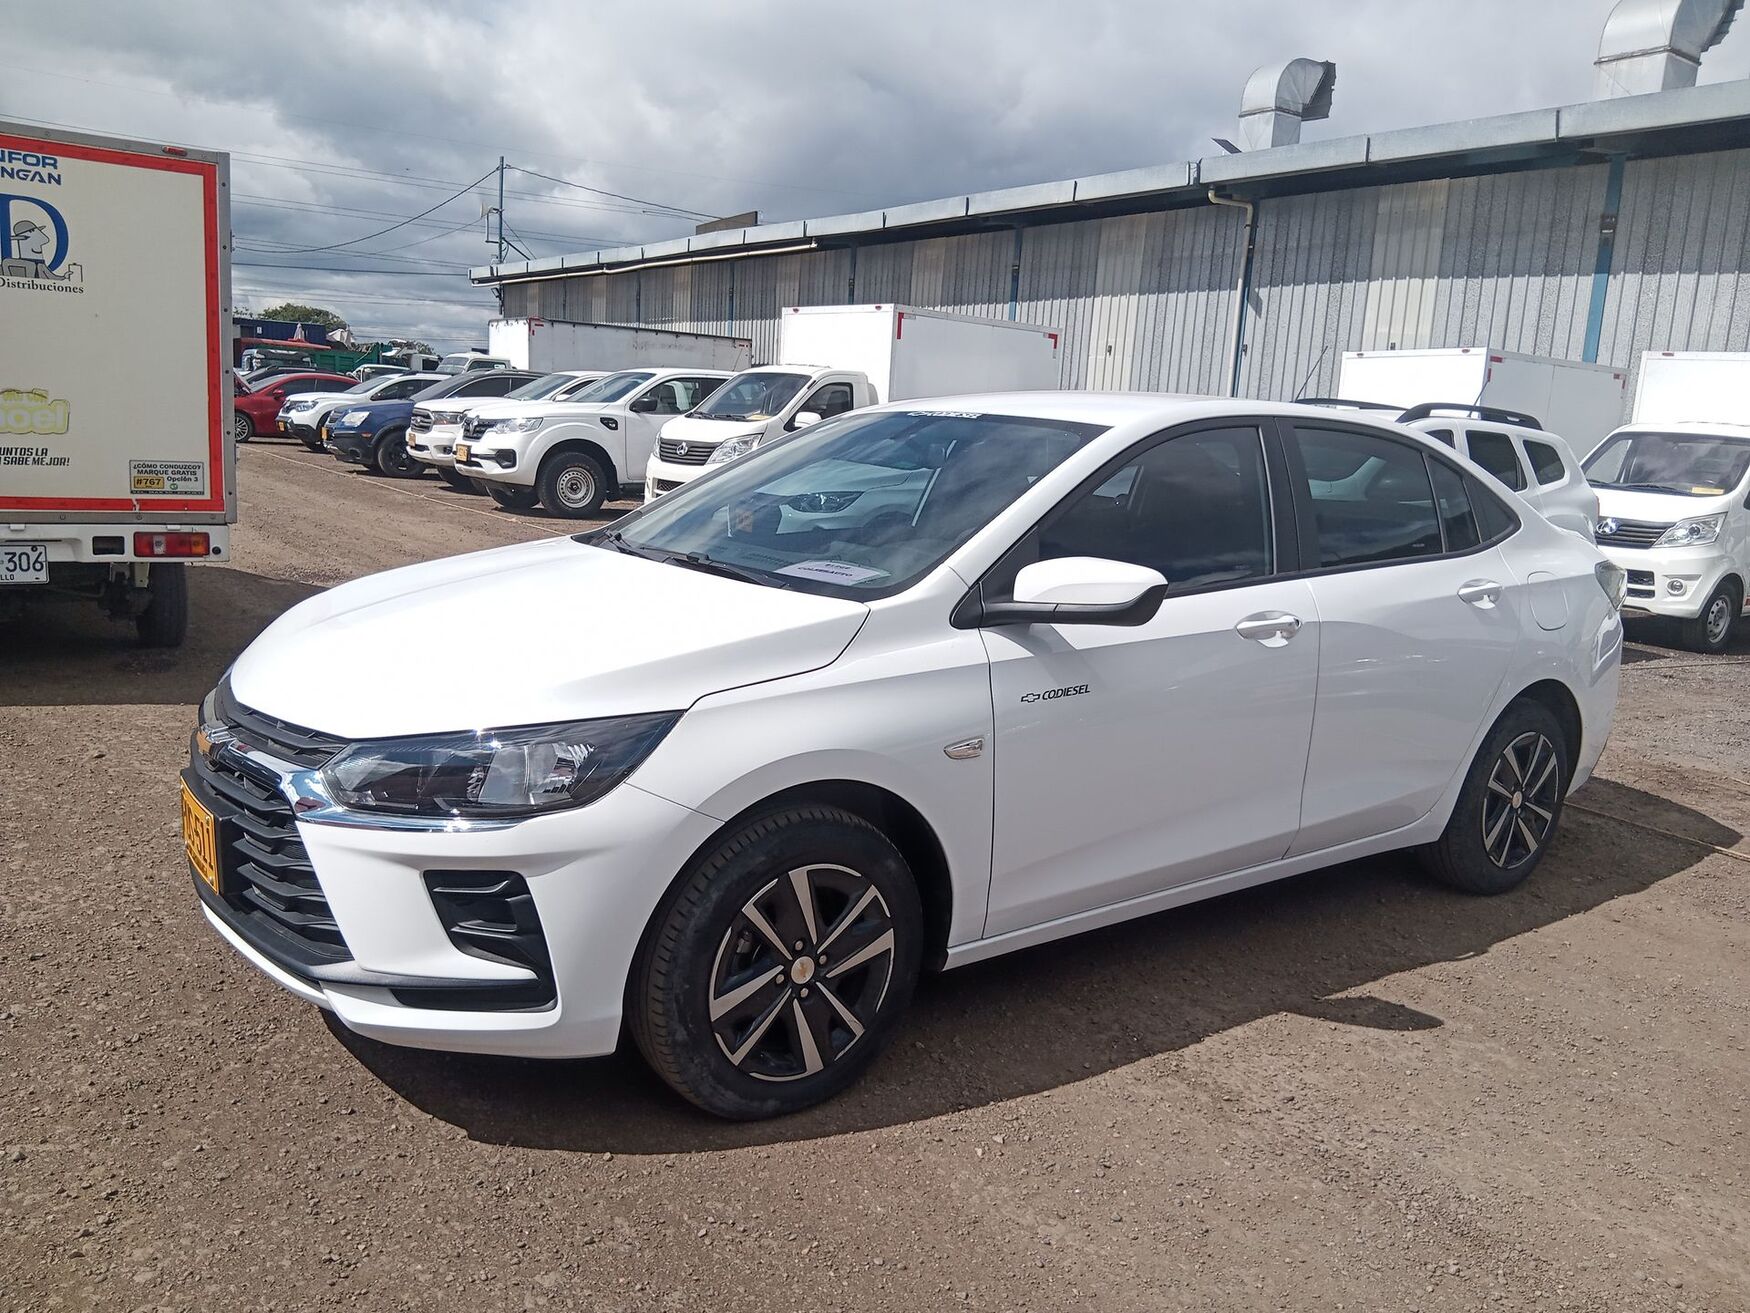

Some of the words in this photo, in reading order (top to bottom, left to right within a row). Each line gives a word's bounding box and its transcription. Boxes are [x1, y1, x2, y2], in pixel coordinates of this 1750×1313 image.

[0, 166, 62, 186] NGAN
[35, 447, 48, 457] LA
[3, 456, 30, 466] SABE
[31, 457, 70, 467] MEJOR!
[133, 462, 158, 470] ¿CÓMO
[136, 478, 162, 486] #767
[166, 475, 192, 483] Opción
[4, 551, 44, 572] 306
[1042, 684, 1091, 700] CODIESEL
